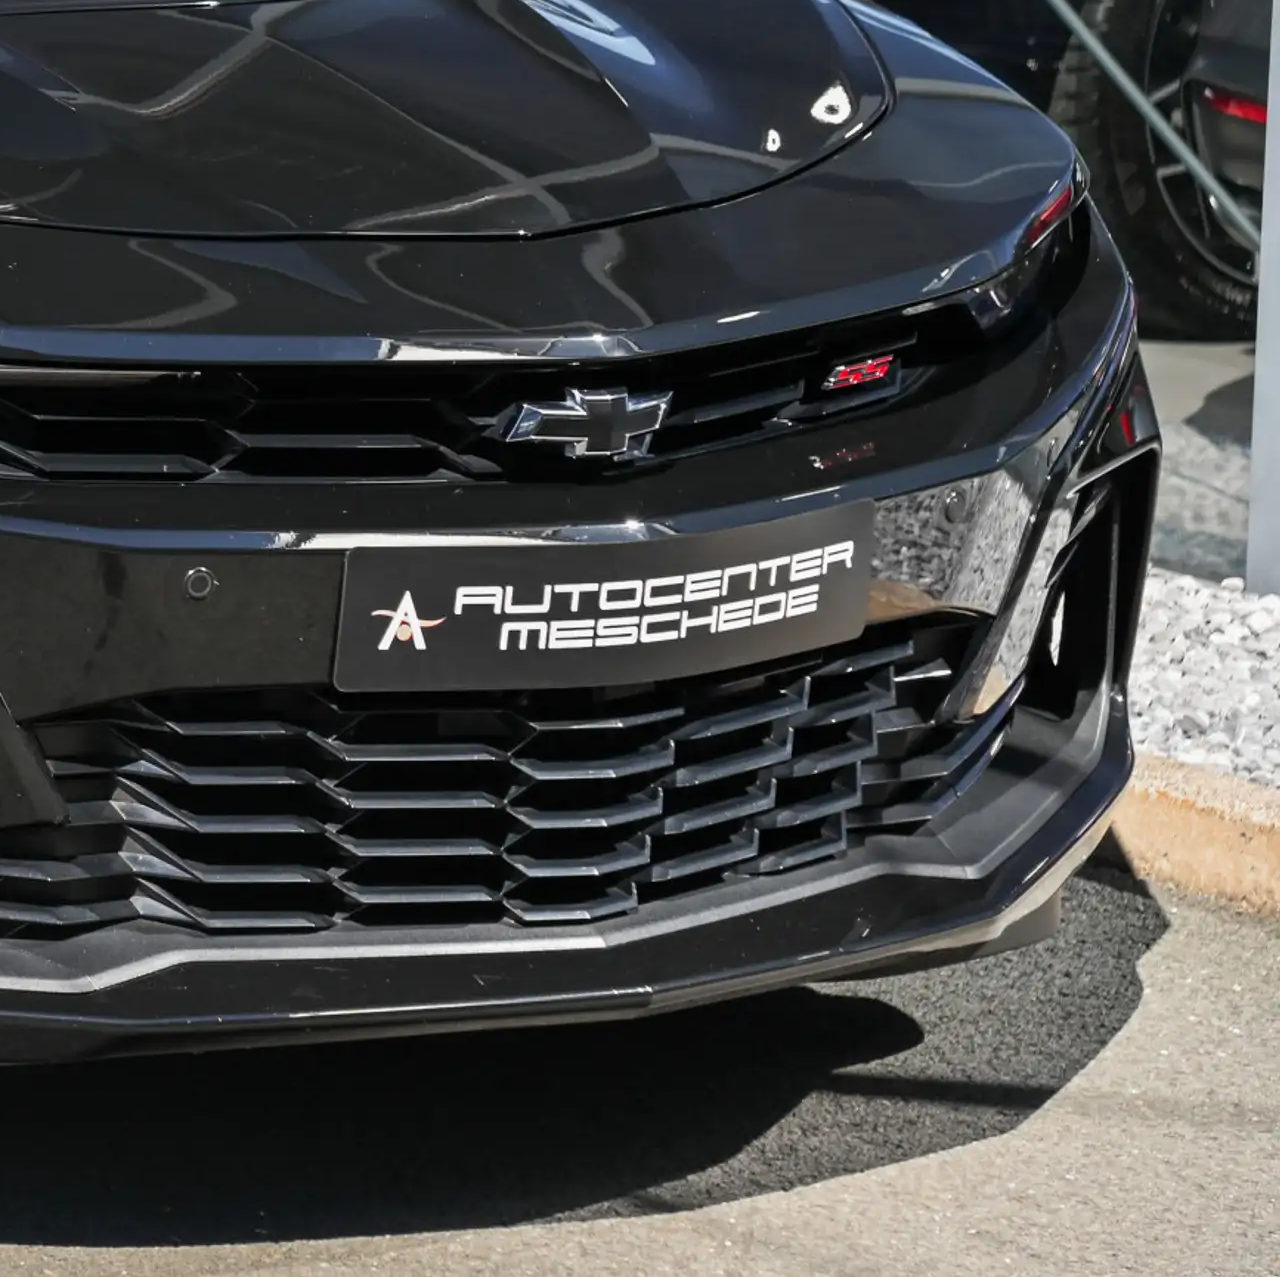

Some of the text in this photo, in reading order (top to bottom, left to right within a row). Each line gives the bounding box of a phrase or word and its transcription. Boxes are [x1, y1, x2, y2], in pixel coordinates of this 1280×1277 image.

[821, 354, 894, 390] SS
[454, 540, 854, 615] AUTOCENTER
[499, 584, 819, 650] MESCHEDE
